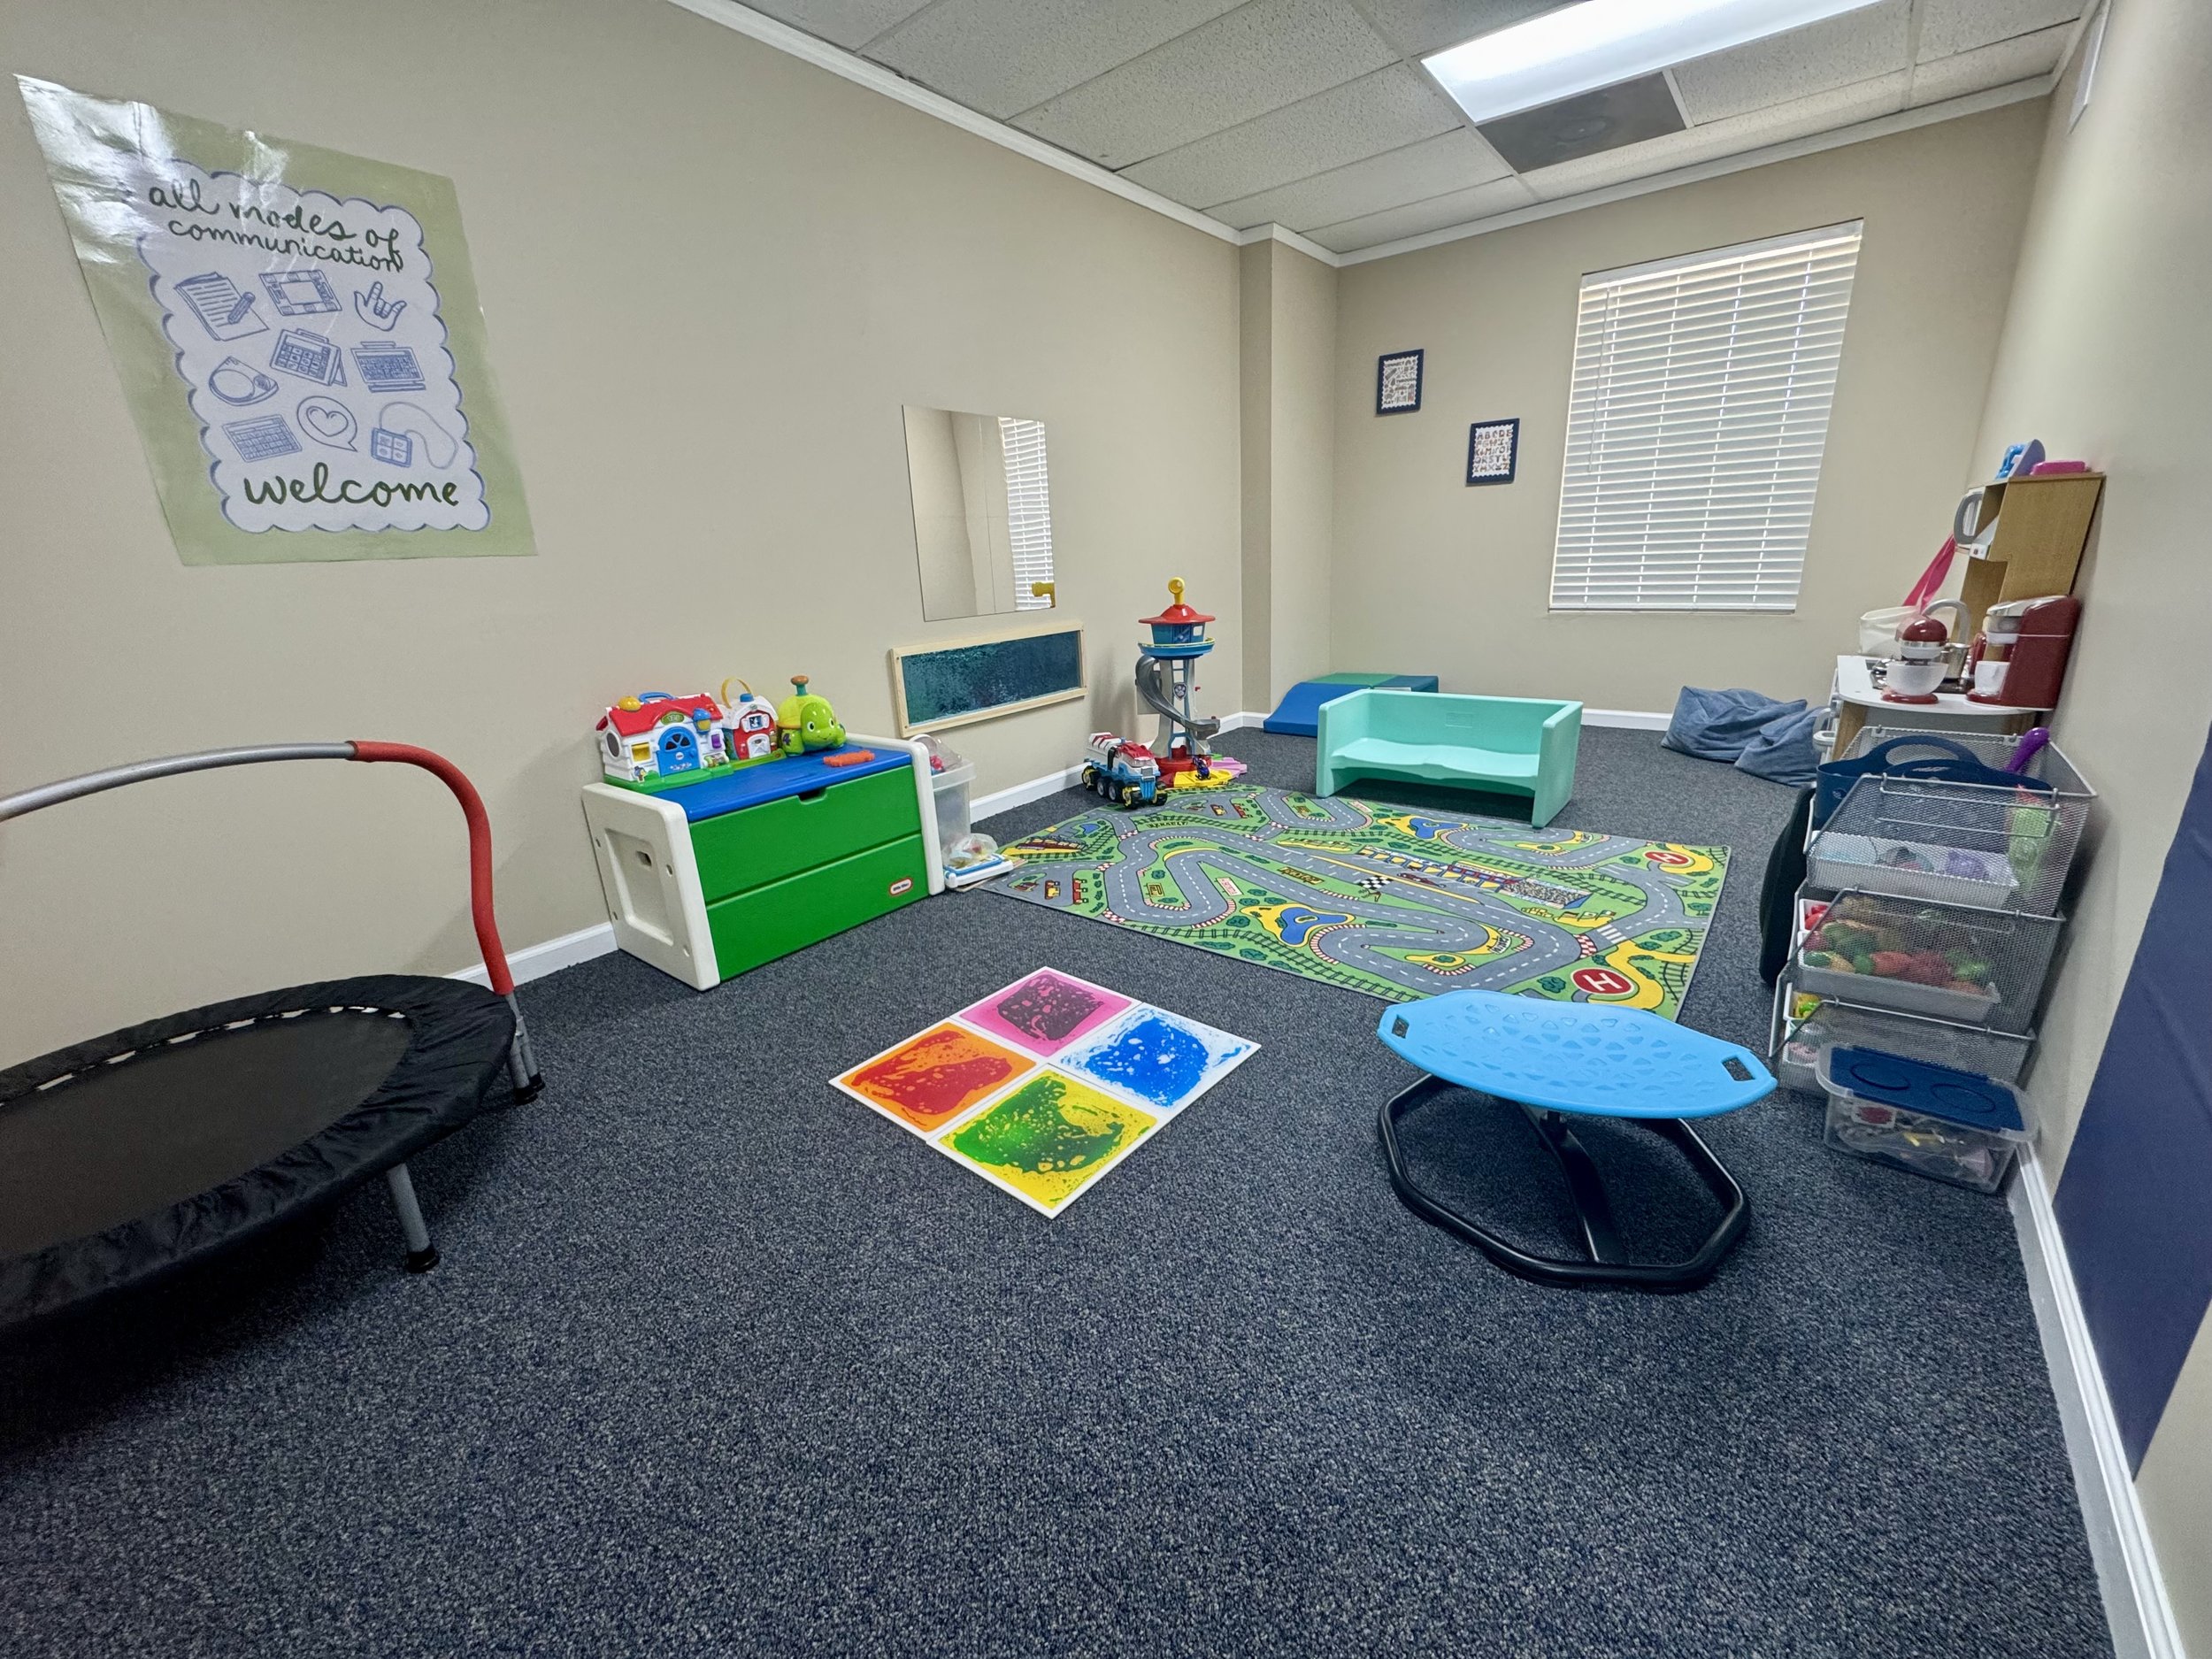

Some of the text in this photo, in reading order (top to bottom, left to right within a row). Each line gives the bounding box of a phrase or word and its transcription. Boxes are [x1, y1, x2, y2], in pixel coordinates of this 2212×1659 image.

[149, 179, 400, 267] all modes of
[168, 220, 404, 273] communication
[243, 462, 459, 507] welcome
[1582, 972, 1623, 992] H
